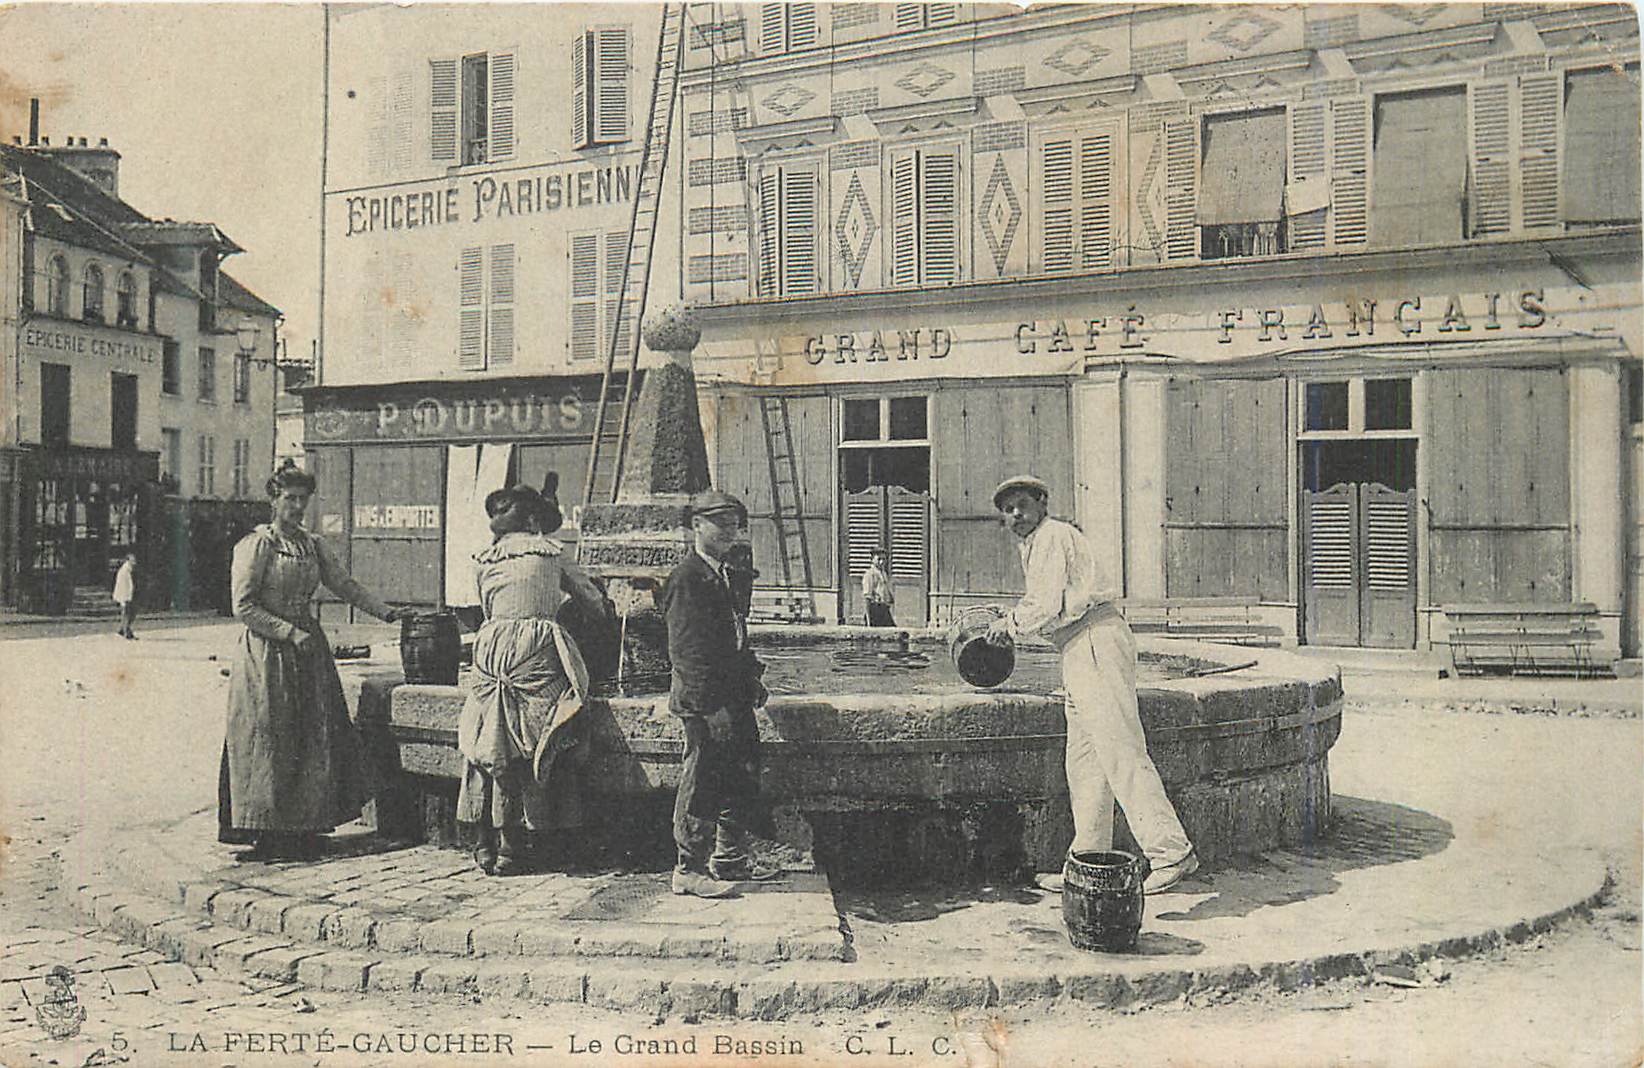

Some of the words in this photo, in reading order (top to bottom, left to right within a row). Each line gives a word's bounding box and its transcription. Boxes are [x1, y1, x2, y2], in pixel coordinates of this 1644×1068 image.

[345, 187, 460, 237] EPICERIE
[472, 164, 642, 223] PARISIENN
[26, 329, 86, 354] EPICERIE
[91, 339, 156, 364] CENTRALE
[803, 327, 952, 366] GRAND
[1013, 303, 1147, 355] CAFÉ
[412, 393, 585, 435] DUPUIS
